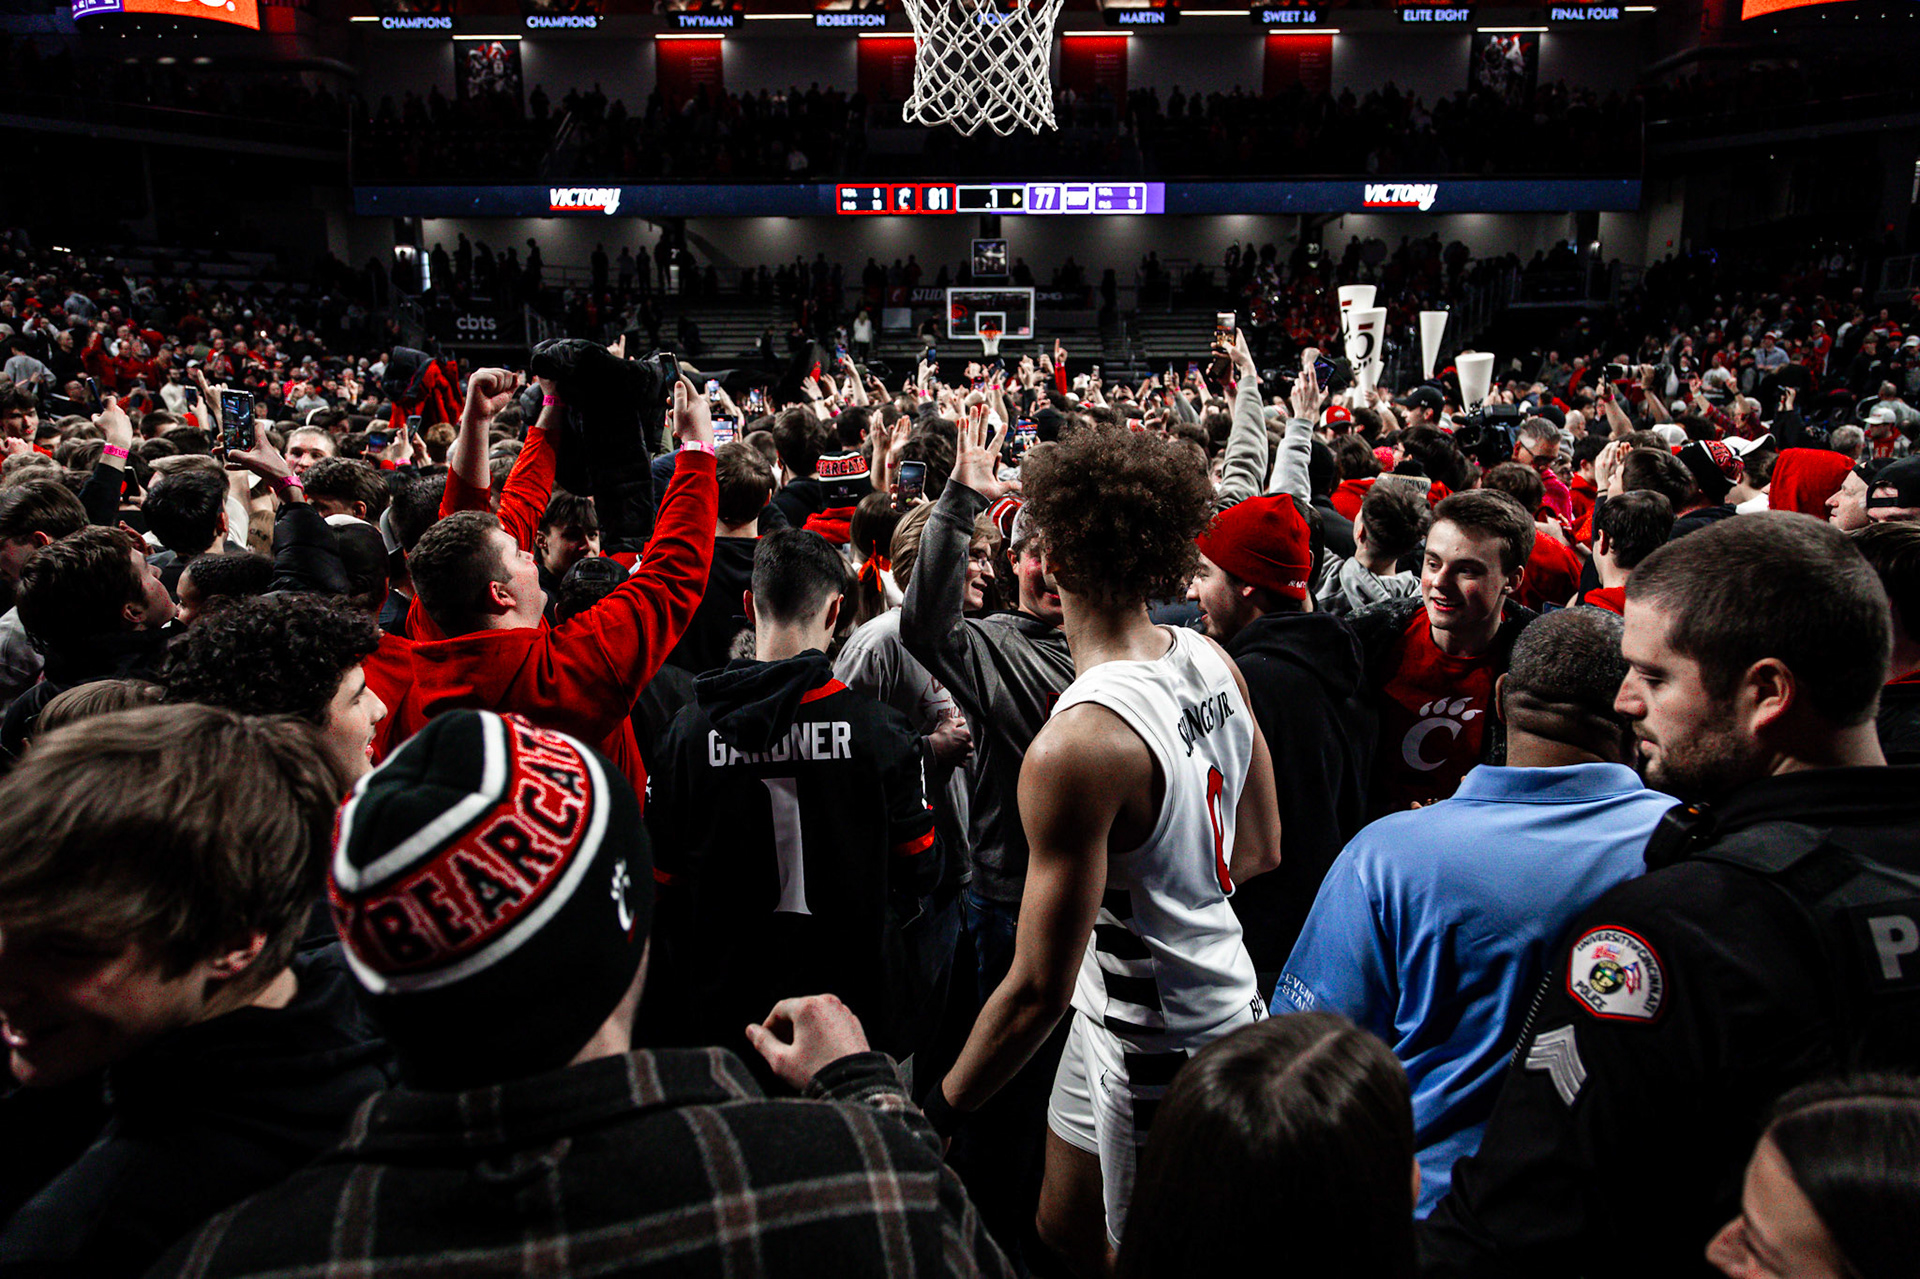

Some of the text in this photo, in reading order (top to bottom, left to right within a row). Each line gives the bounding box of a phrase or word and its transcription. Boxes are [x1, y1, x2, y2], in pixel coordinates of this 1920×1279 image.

[526, 15, 598, 28] CHAMPIONS
[677, 15, 733, 27] TWYMAN
[815, 14, 886, 27] ROBERTSON
[1119, 11, 1165, 24] MARTIN
[1262, 10, 1316, 23] SWEET 16
[1403, 9, 1470, 21] ELITE EIGHT
[1551, 7, 1618, 20] FINAL FOUR
[381, 16, 453, 29] CHAMPIONS
[549, 188, 621, 215] VICTORY
[928, 187, 948, 210] 81
[1034, 187, 1056, 210] 77
[1363, 184, 1437, 211] VICTORY
[456, 313, 497, 330] cbts
[761, 777, 812, 915] 1
[1576, 932, 1633, 951] UNIVERSITY
[1638, 949, 1661, 1013] CINCINNATI
[1285, 973, 1315, 1006] EVENT
[1575, 980, 1608, 1011] POLICE
